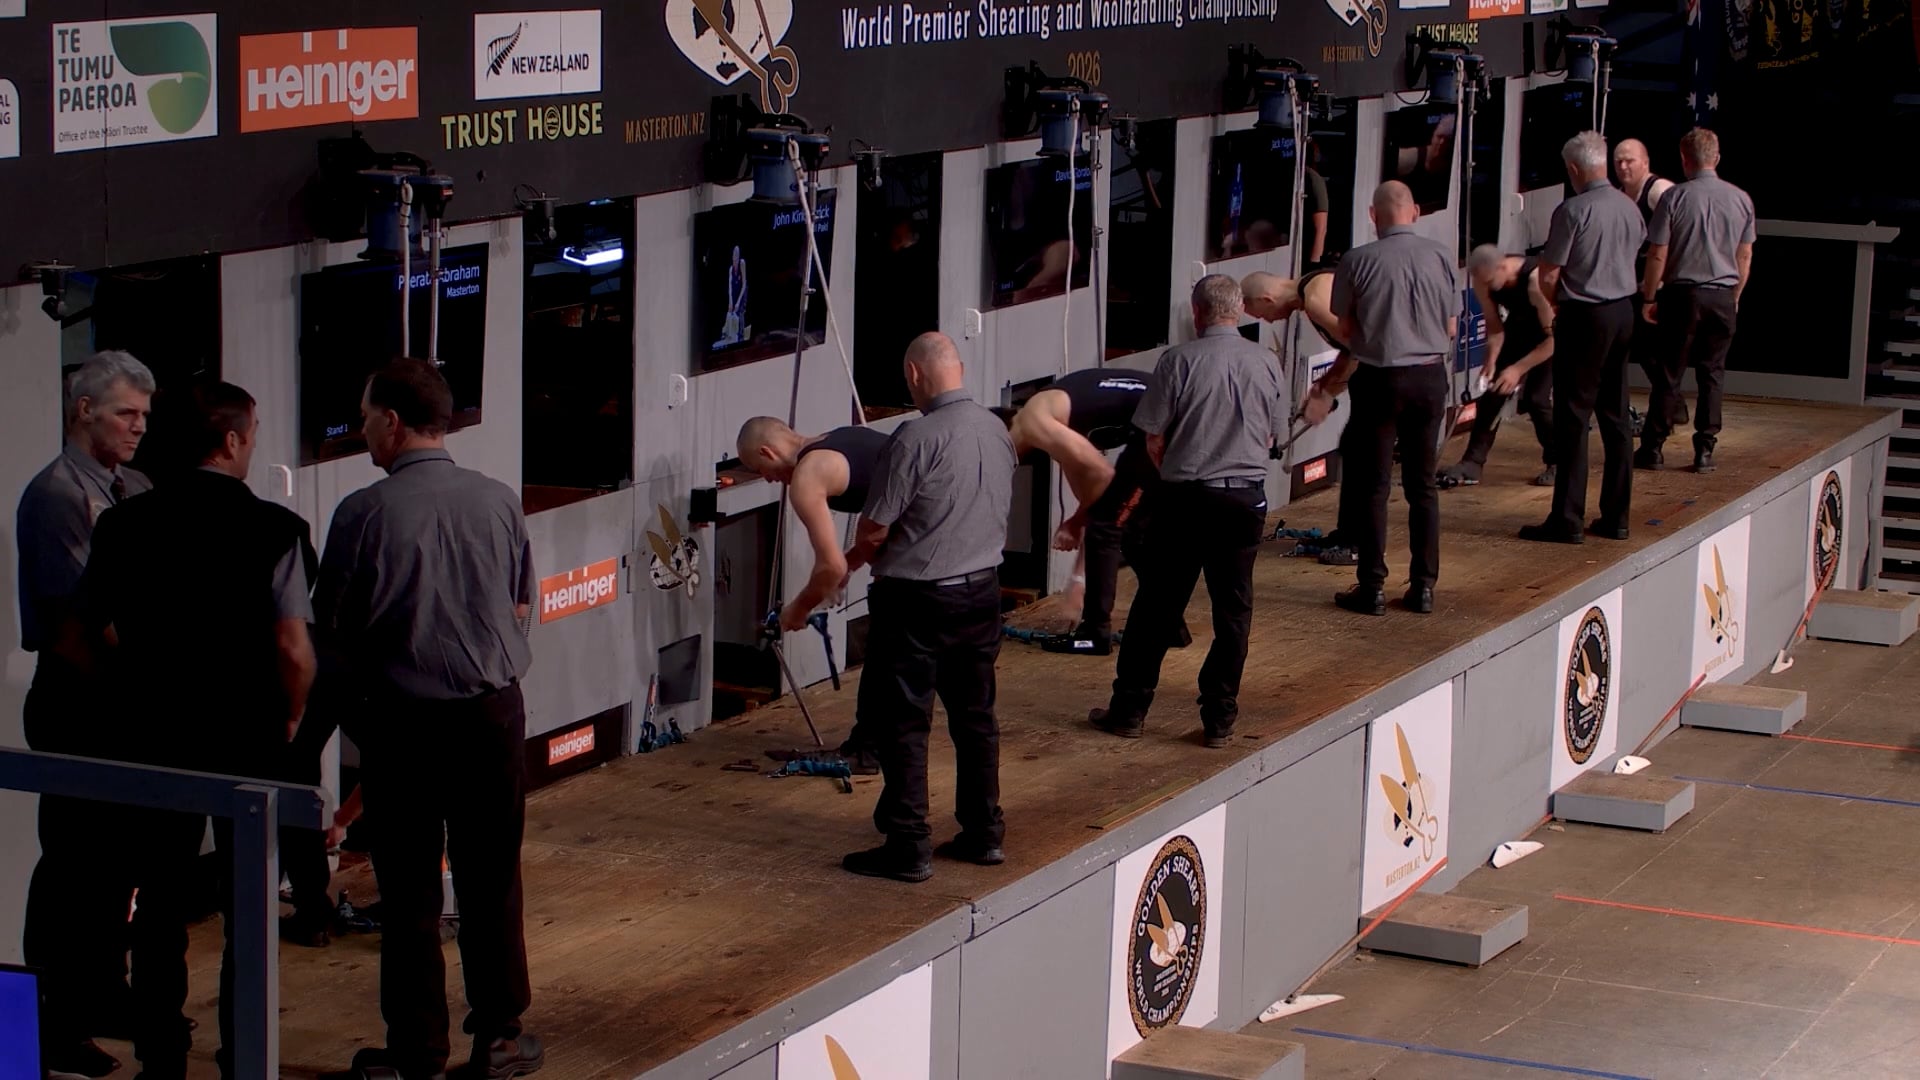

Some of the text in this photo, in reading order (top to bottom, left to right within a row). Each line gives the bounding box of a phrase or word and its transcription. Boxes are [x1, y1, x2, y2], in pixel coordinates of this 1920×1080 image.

[842, 5, 893, 49] World
[902, 2, 971, 44] Premier
[978, 0, 1050, 39] Shearing
[1056, 0, 1083, 31] and
[1091, 0, 1184, 28] Woolhandling
[58, 28, 80, 54] TE
[58, 54, 114, 83] TUMU
[247, 32, 414, 116] Heiniger
[511, 53, 589, 74] NEW ZEALAND
[1067, 51, 1101, 86] 2026
[59, 82, 137, 112] PAEROA
[59, 131, 79, 143] Office
[80, 130, 88, 140] of
[89, 128, 100, 139] the
[122, 125, 148, 136] Trustee
[441, 102, 603, 149] TRUST HOUSE
[625, 112, 706, 144] MASTERTON.NZ
[773, 211, 791, 231] John
[446, 283, 480, 299] Masterton
[326, 424, 344, 437] Stand
[543, 566, 617, 614] Heiniger
[550, 731, 594, 760] Heiniger
[1138, 855, 1200, 936] GOLDEN SHEARS
[1135, 957, 1149, 1013] WORLD
[1148, 924, 1200, 1023] CHAMPIONSHIPS
